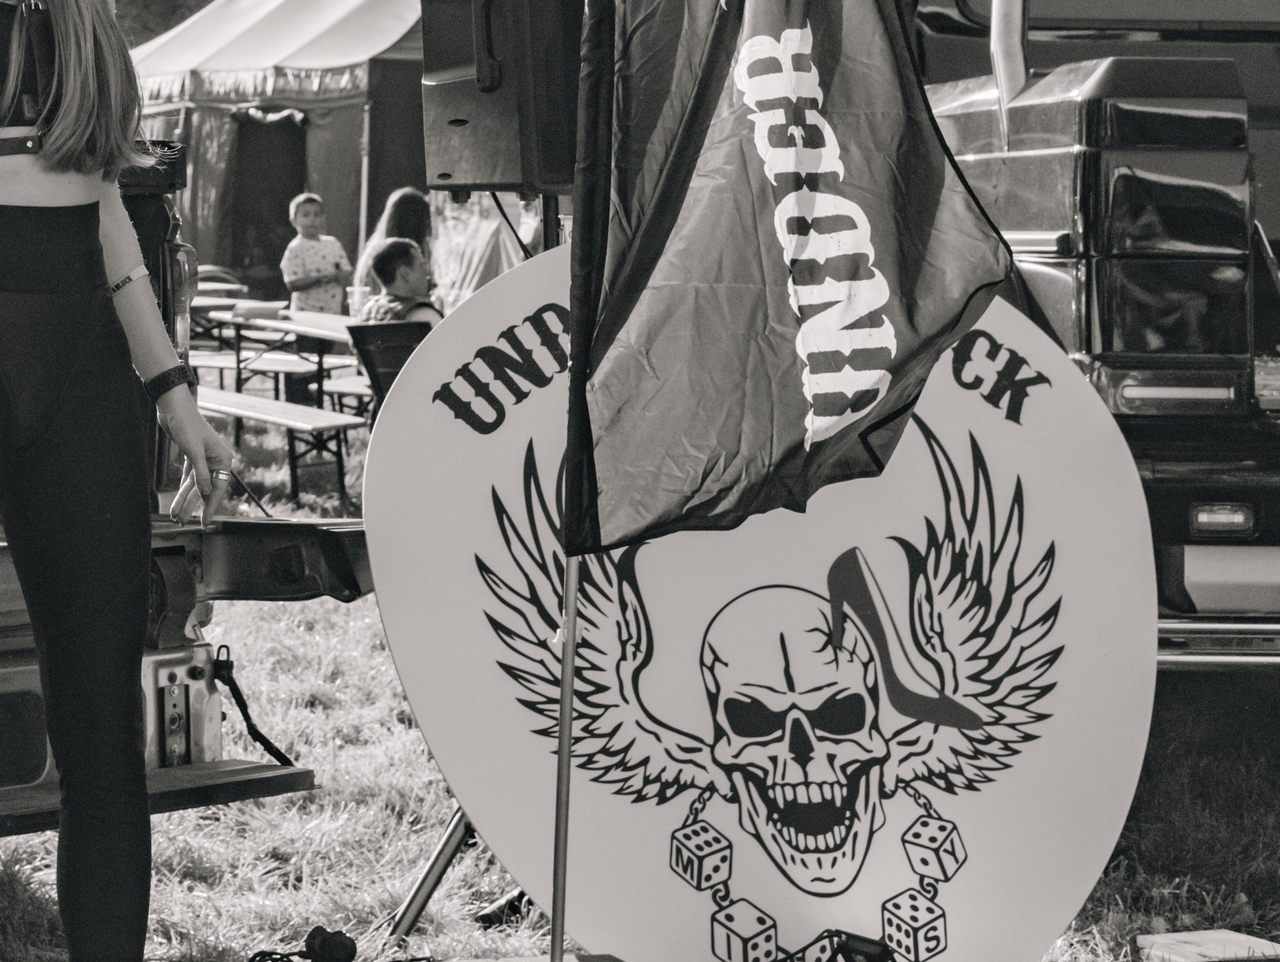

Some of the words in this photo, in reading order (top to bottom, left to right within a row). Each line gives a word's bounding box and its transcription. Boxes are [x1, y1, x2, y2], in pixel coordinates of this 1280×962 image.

[734, 18, 897, 452] UNDER
[432, 302, 571, 435] UND
[675, 844, 695, 882] M
[923, 925, 942, 954] S
